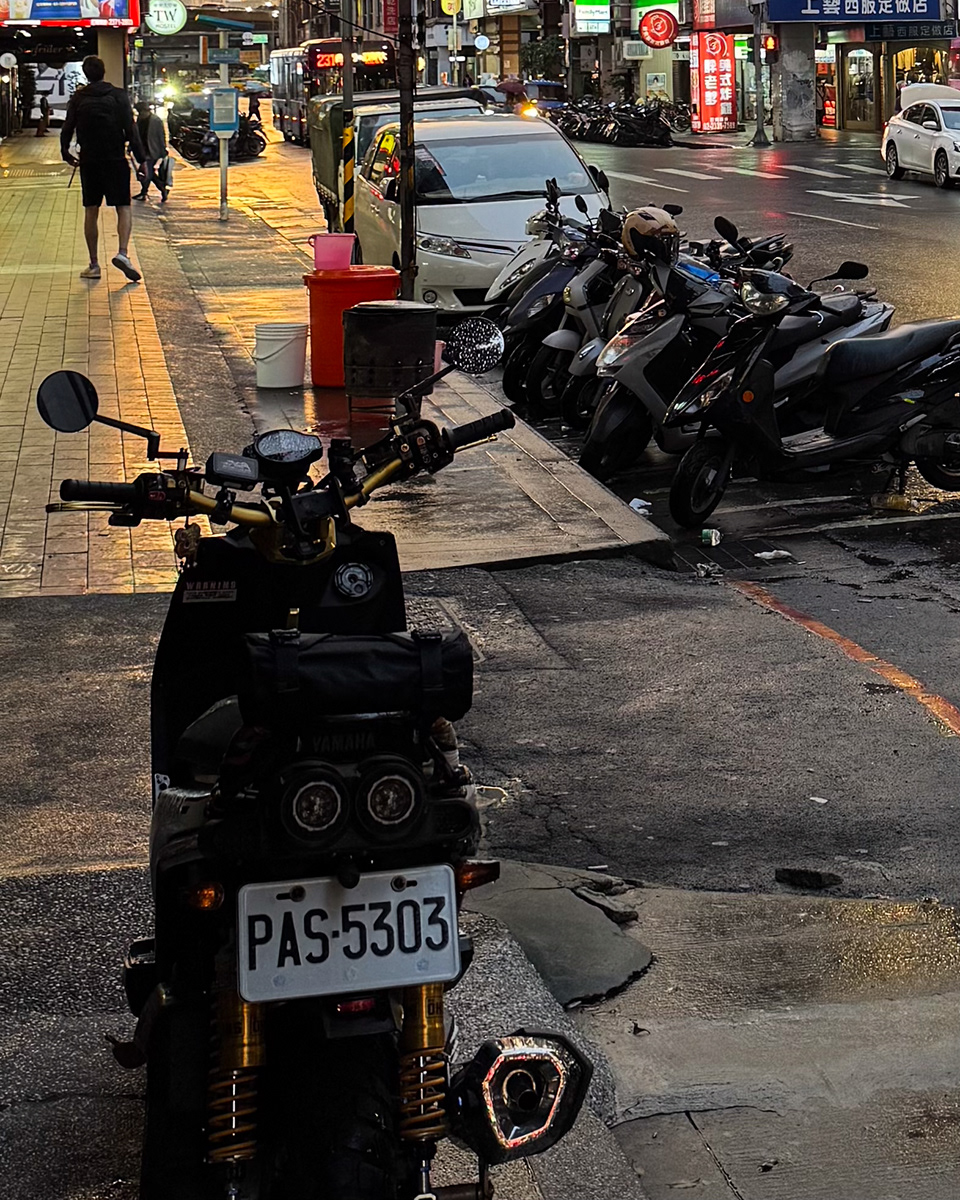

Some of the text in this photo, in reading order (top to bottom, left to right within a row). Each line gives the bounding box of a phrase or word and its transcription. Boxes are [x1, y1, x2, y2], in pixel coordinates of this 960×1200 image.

[153, 8, 177, 22] TW
[869, 23, 956, 38] 上藝西服定做店
[312, 732, 376, 753] YAMAHA
[247, 895, 451, 972] PAS-5303
